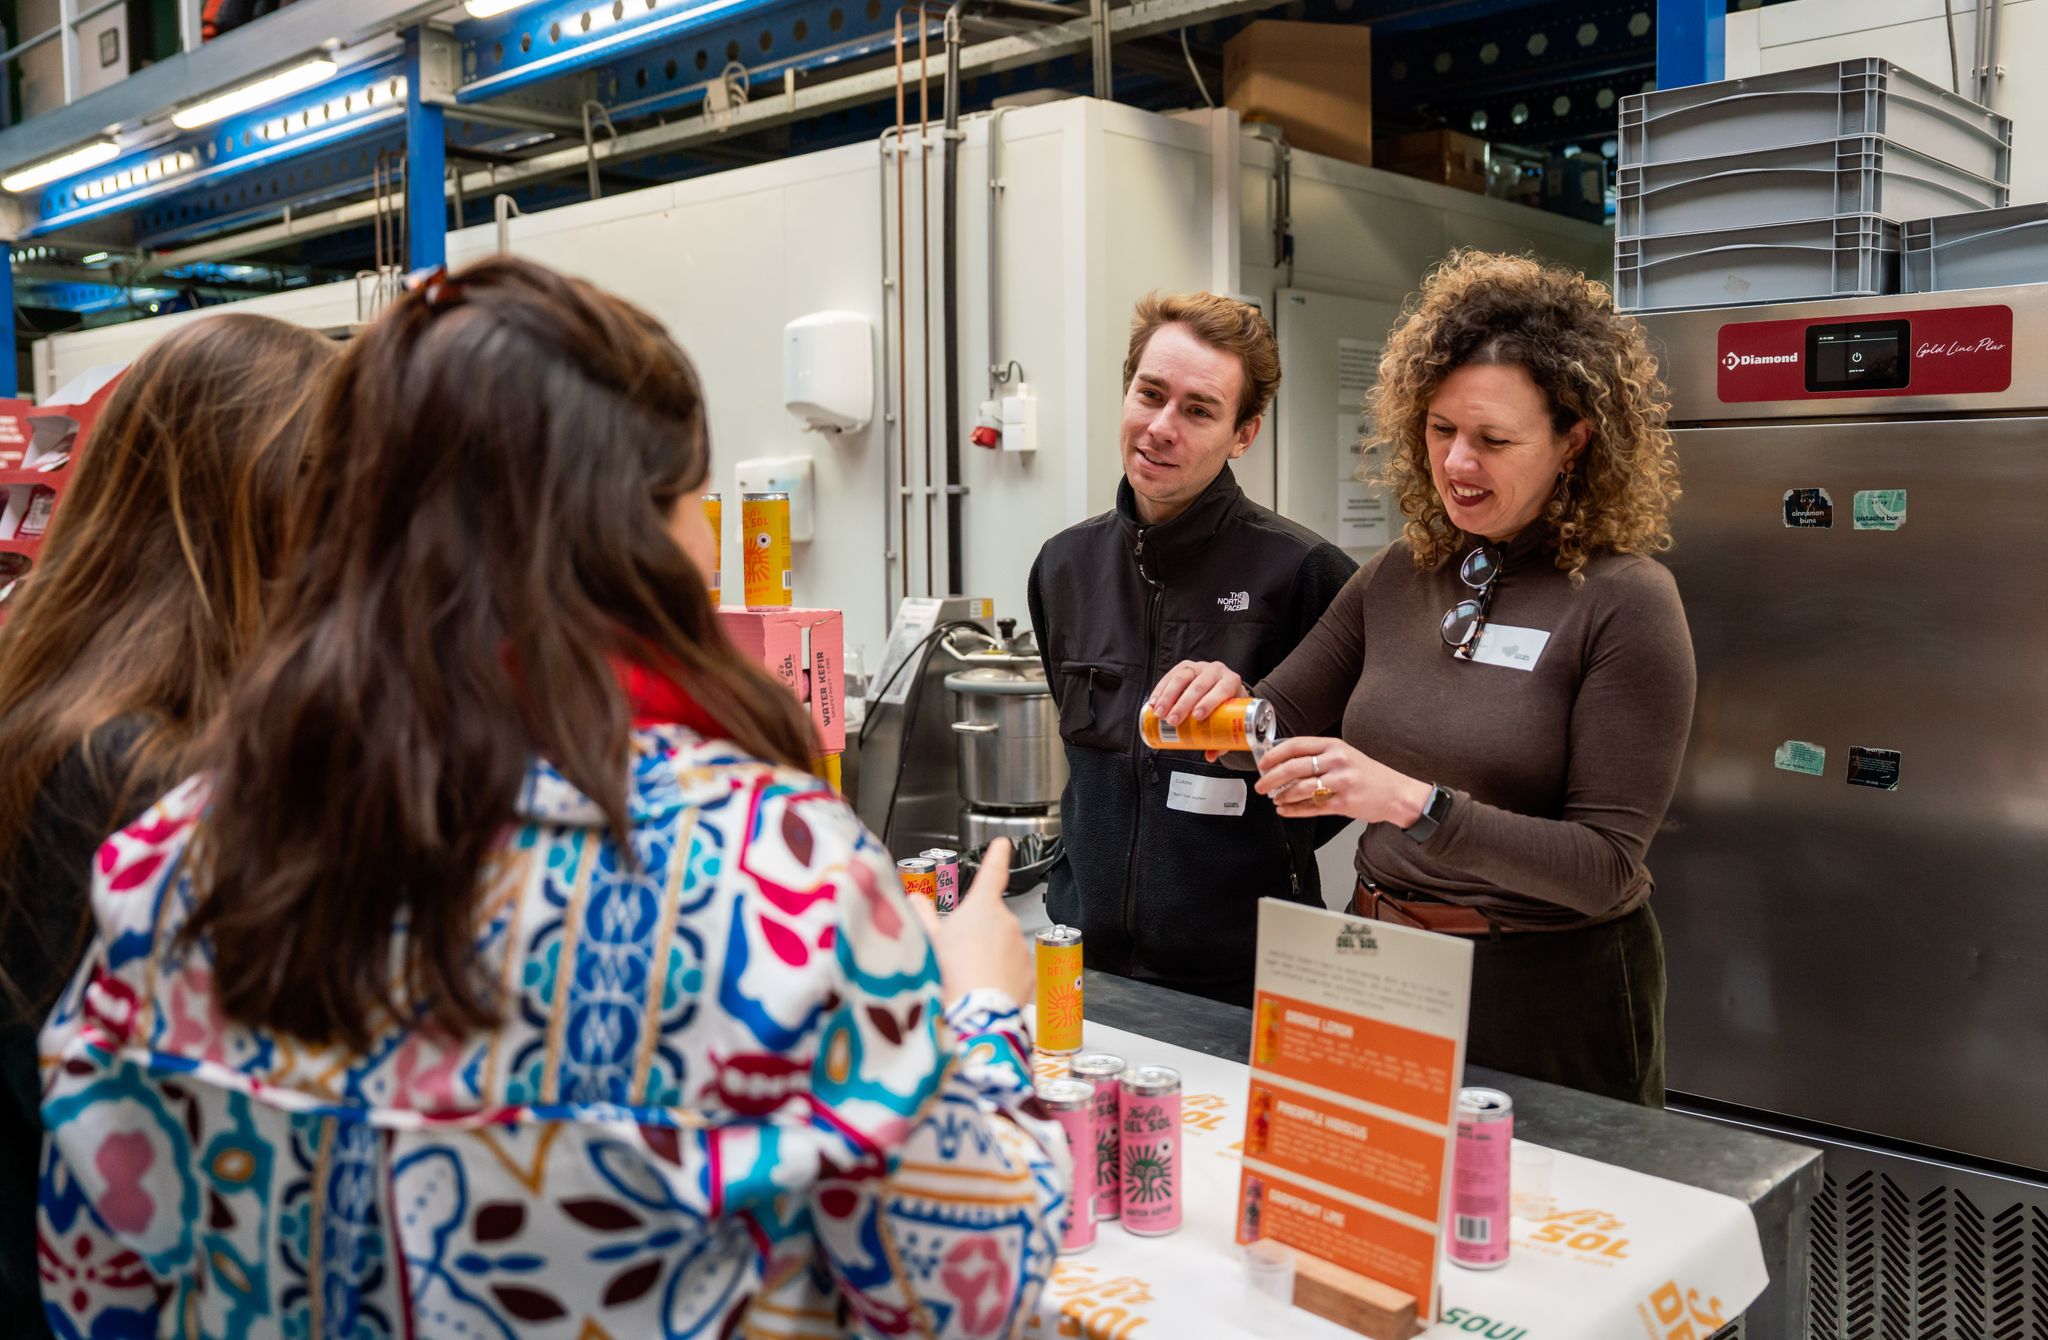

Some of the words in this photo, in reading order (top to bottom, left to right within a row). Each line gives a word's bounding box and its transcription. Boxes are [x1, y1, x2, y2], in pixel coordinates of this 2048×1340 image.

[1741, 352, 1798, 365] Diamond
[1915, 342, 1945, 358] Gold
[1946, 341, 1974, 356] Line
[1974, 337, 2005, 353] Plus
[1230, 591, 1243, 599] THE
[816, 652, 826, 684] KEFIR
[820, 687, 831, 727] WATER
[1529, 1223, 1629, 1259] SOL
